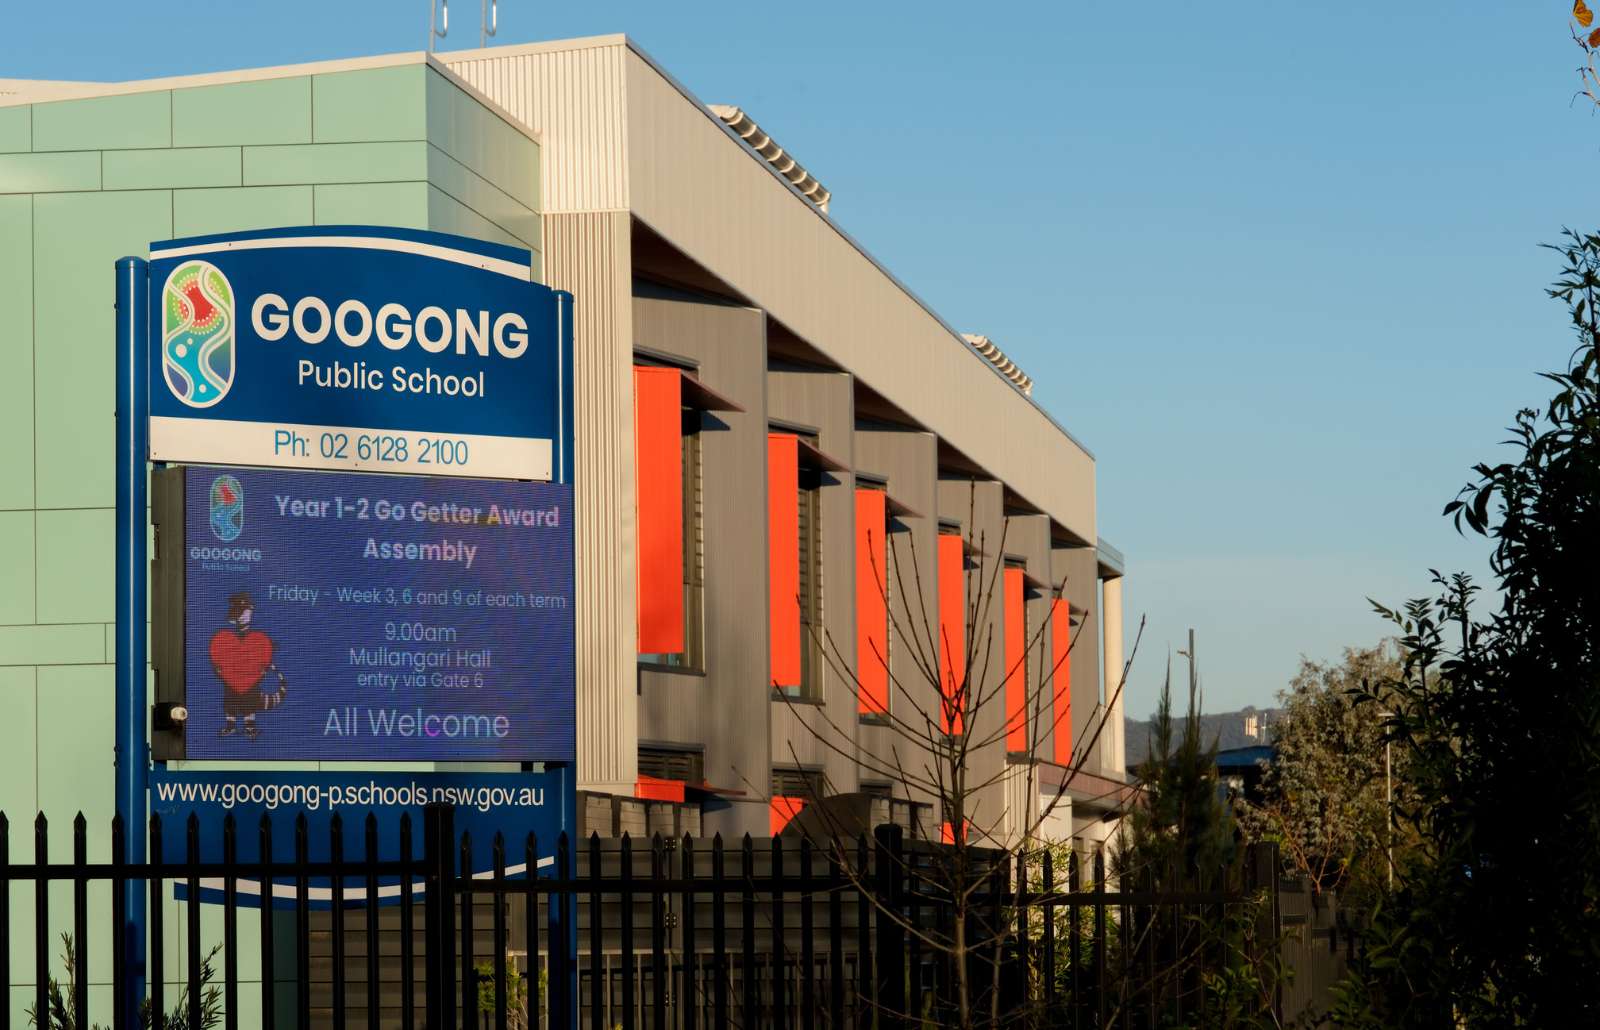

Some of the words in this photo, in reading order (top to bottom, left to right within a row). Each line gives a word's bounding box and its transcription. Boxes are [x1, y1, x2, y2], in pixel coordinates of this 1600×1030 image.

[251, 293, 529, 359] GOOGONG
[298, 359, 384, 392] Public
[392, 366, 485, 398] School
[274, 430, 311, 457] Ph:
[320, 432, 348, 459] 02
[357, 435, 409, 463] 6128
[418, 438, 469, 466] 2100
[275, 495, 330, 519] Year
[335, 496, 369, 520] 1-2
[374, 499, 406, 522] Go
[411, 501, 482, 525] Getter
[487, 504, 560, 528] Award
[363, 538, 477, 568] Assembly
[269, 585, 319, 606] Friday
[336, 586, 380, 604] Week
[385, 589, 398, 606] 3,
[403, 589, 412, 604] 6
[417, 589, 448, 606] and
[453, 590, 462, 606] 9
[466, 590, 483, 606] of
[486, 590, 525, 608] each
[530, 592, 567, 609] term
[385, 622, 457, 643] 9.00am
[350, 647, 451, 672] Mullangari
[456, 649, 492, 668] Hall
[357, 674, 397, 691] entry
[402, 672, 426, 687] via
[431, 673, 469, 688] Gate
[474, 673, 484, 688] 6
[324, 708, 358, 737] All
[368, 710, 510, 738] Welcome
[157, 781, 544, 811] www.googong-p.schools.nsw.gov.au
